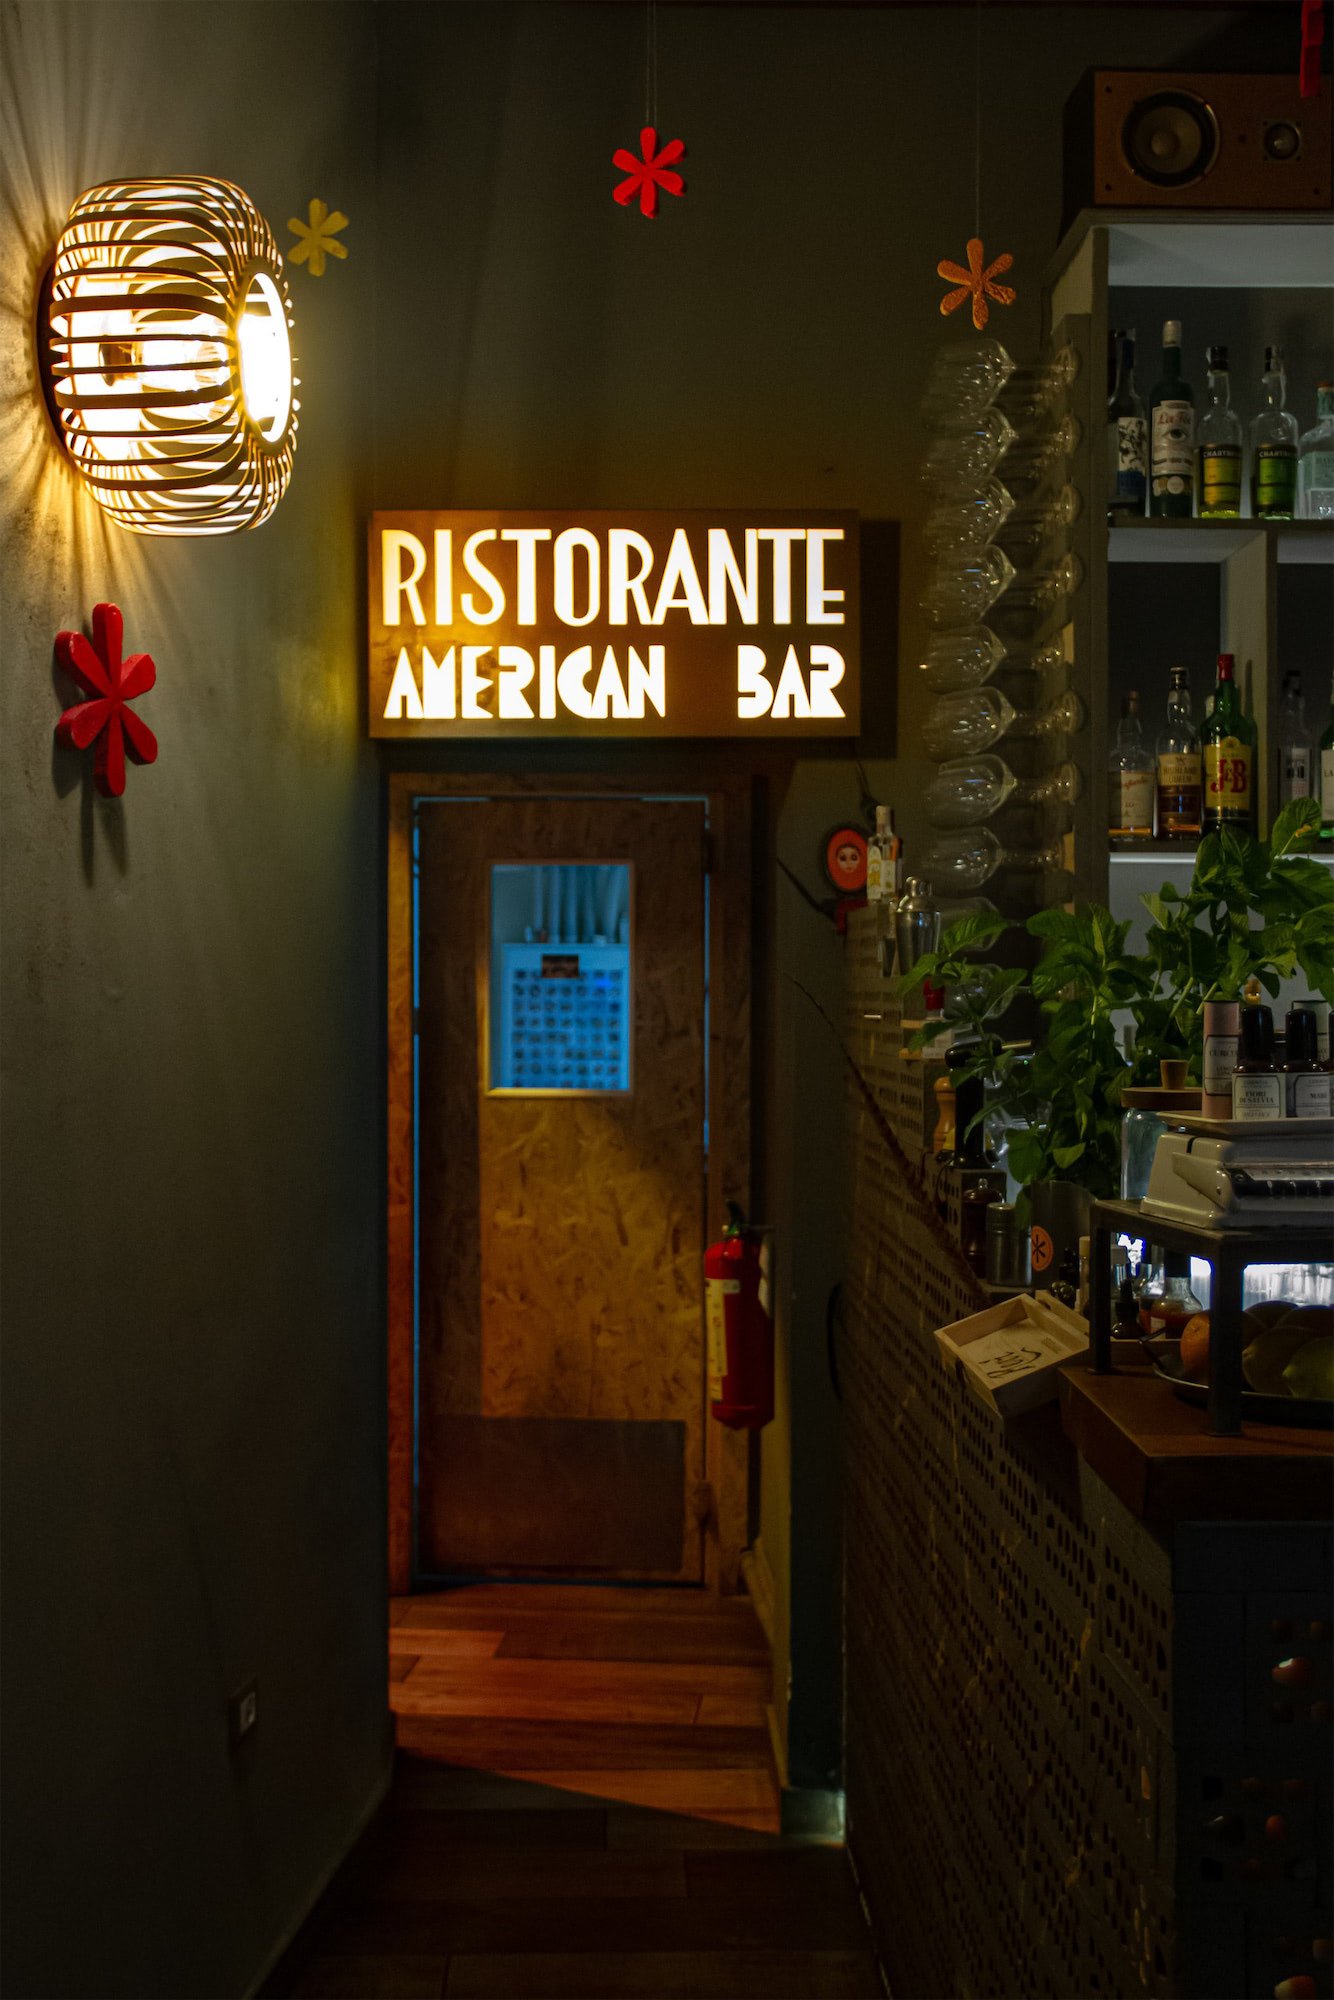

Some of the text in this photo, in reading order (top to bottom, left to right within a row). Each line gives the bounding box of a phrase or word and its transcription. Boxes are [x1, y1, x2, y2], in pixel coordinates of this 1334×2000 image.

[382, 527, 846, 627] RISTORANTE
[383, 643, 846, 719] AMERICAN BAR
